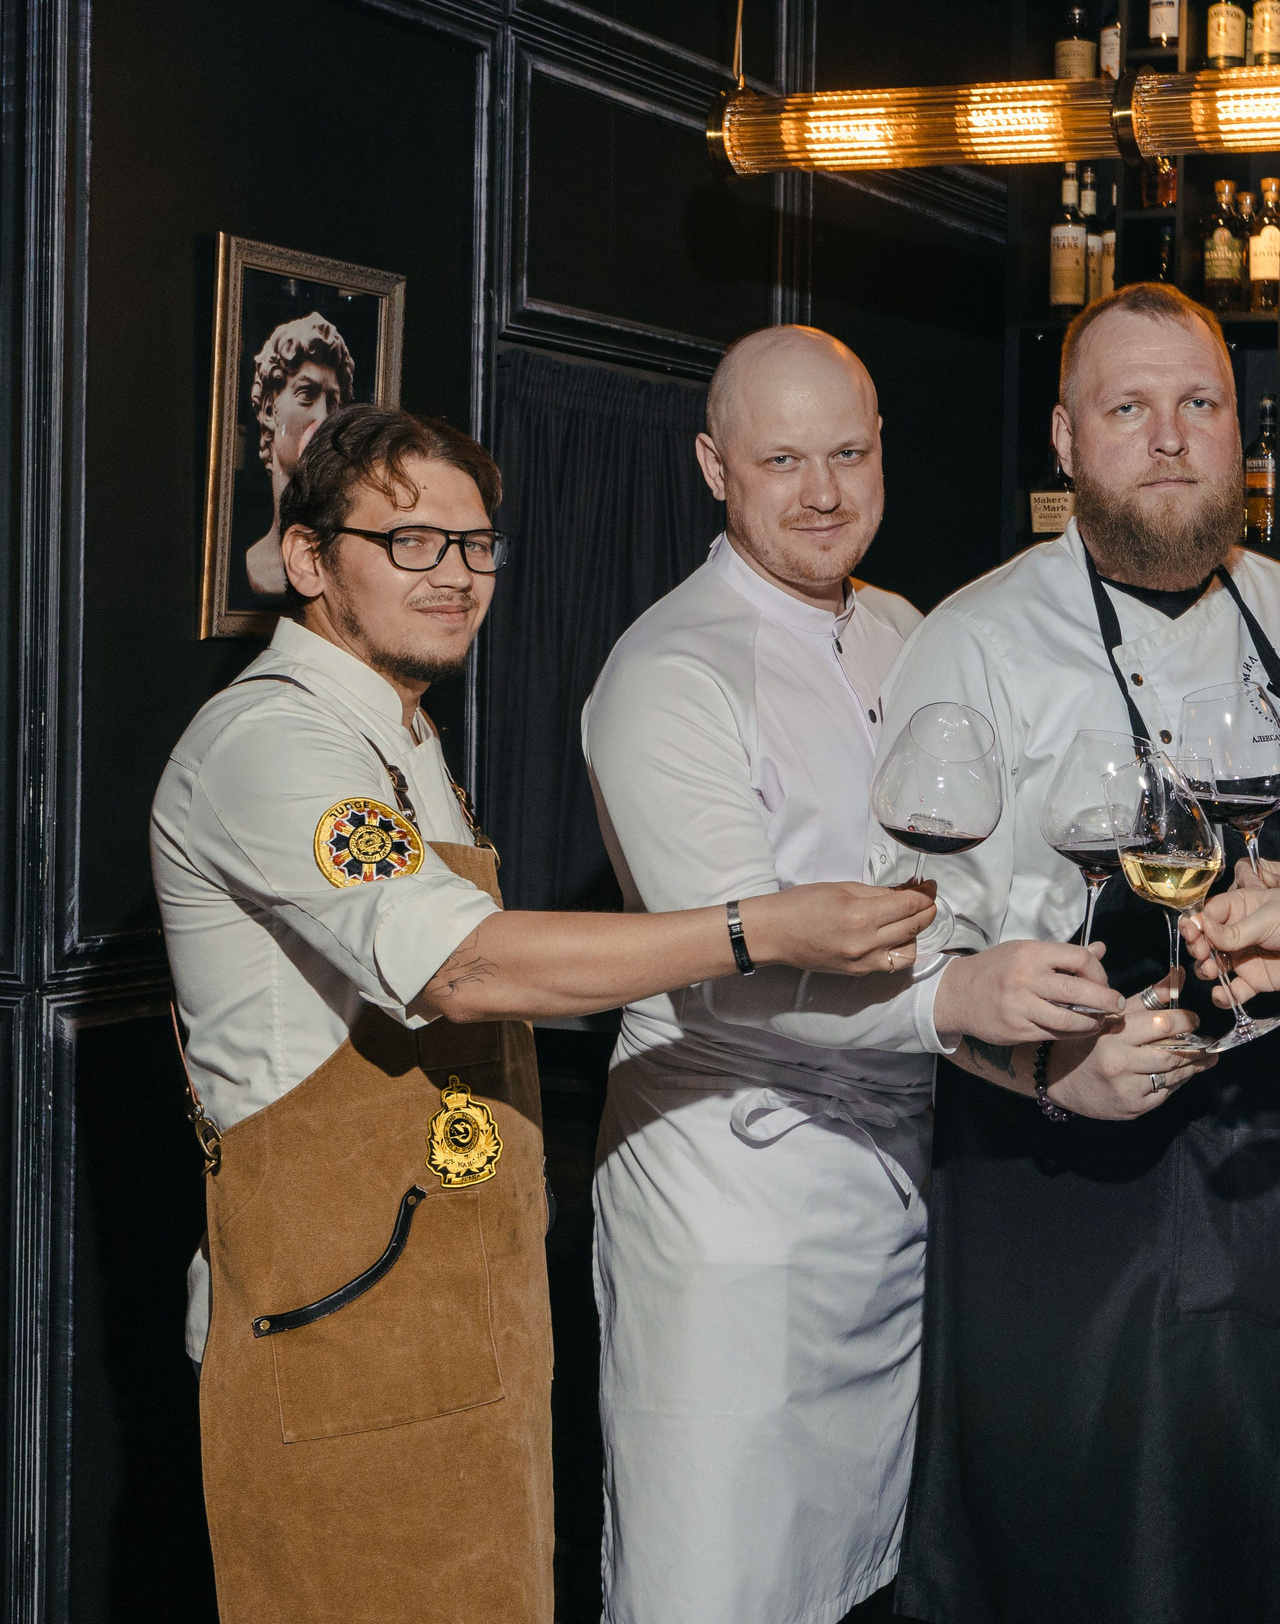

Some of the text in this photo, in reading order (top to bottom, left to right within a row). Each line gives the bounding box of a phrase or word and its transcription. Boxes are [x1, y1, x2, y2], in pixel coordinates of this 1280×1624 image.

[1033, 496, 1069, 504] Maker's
[1042, 504, 1069, 512] Mark
[329, 801, 371, 821] JUDGE
